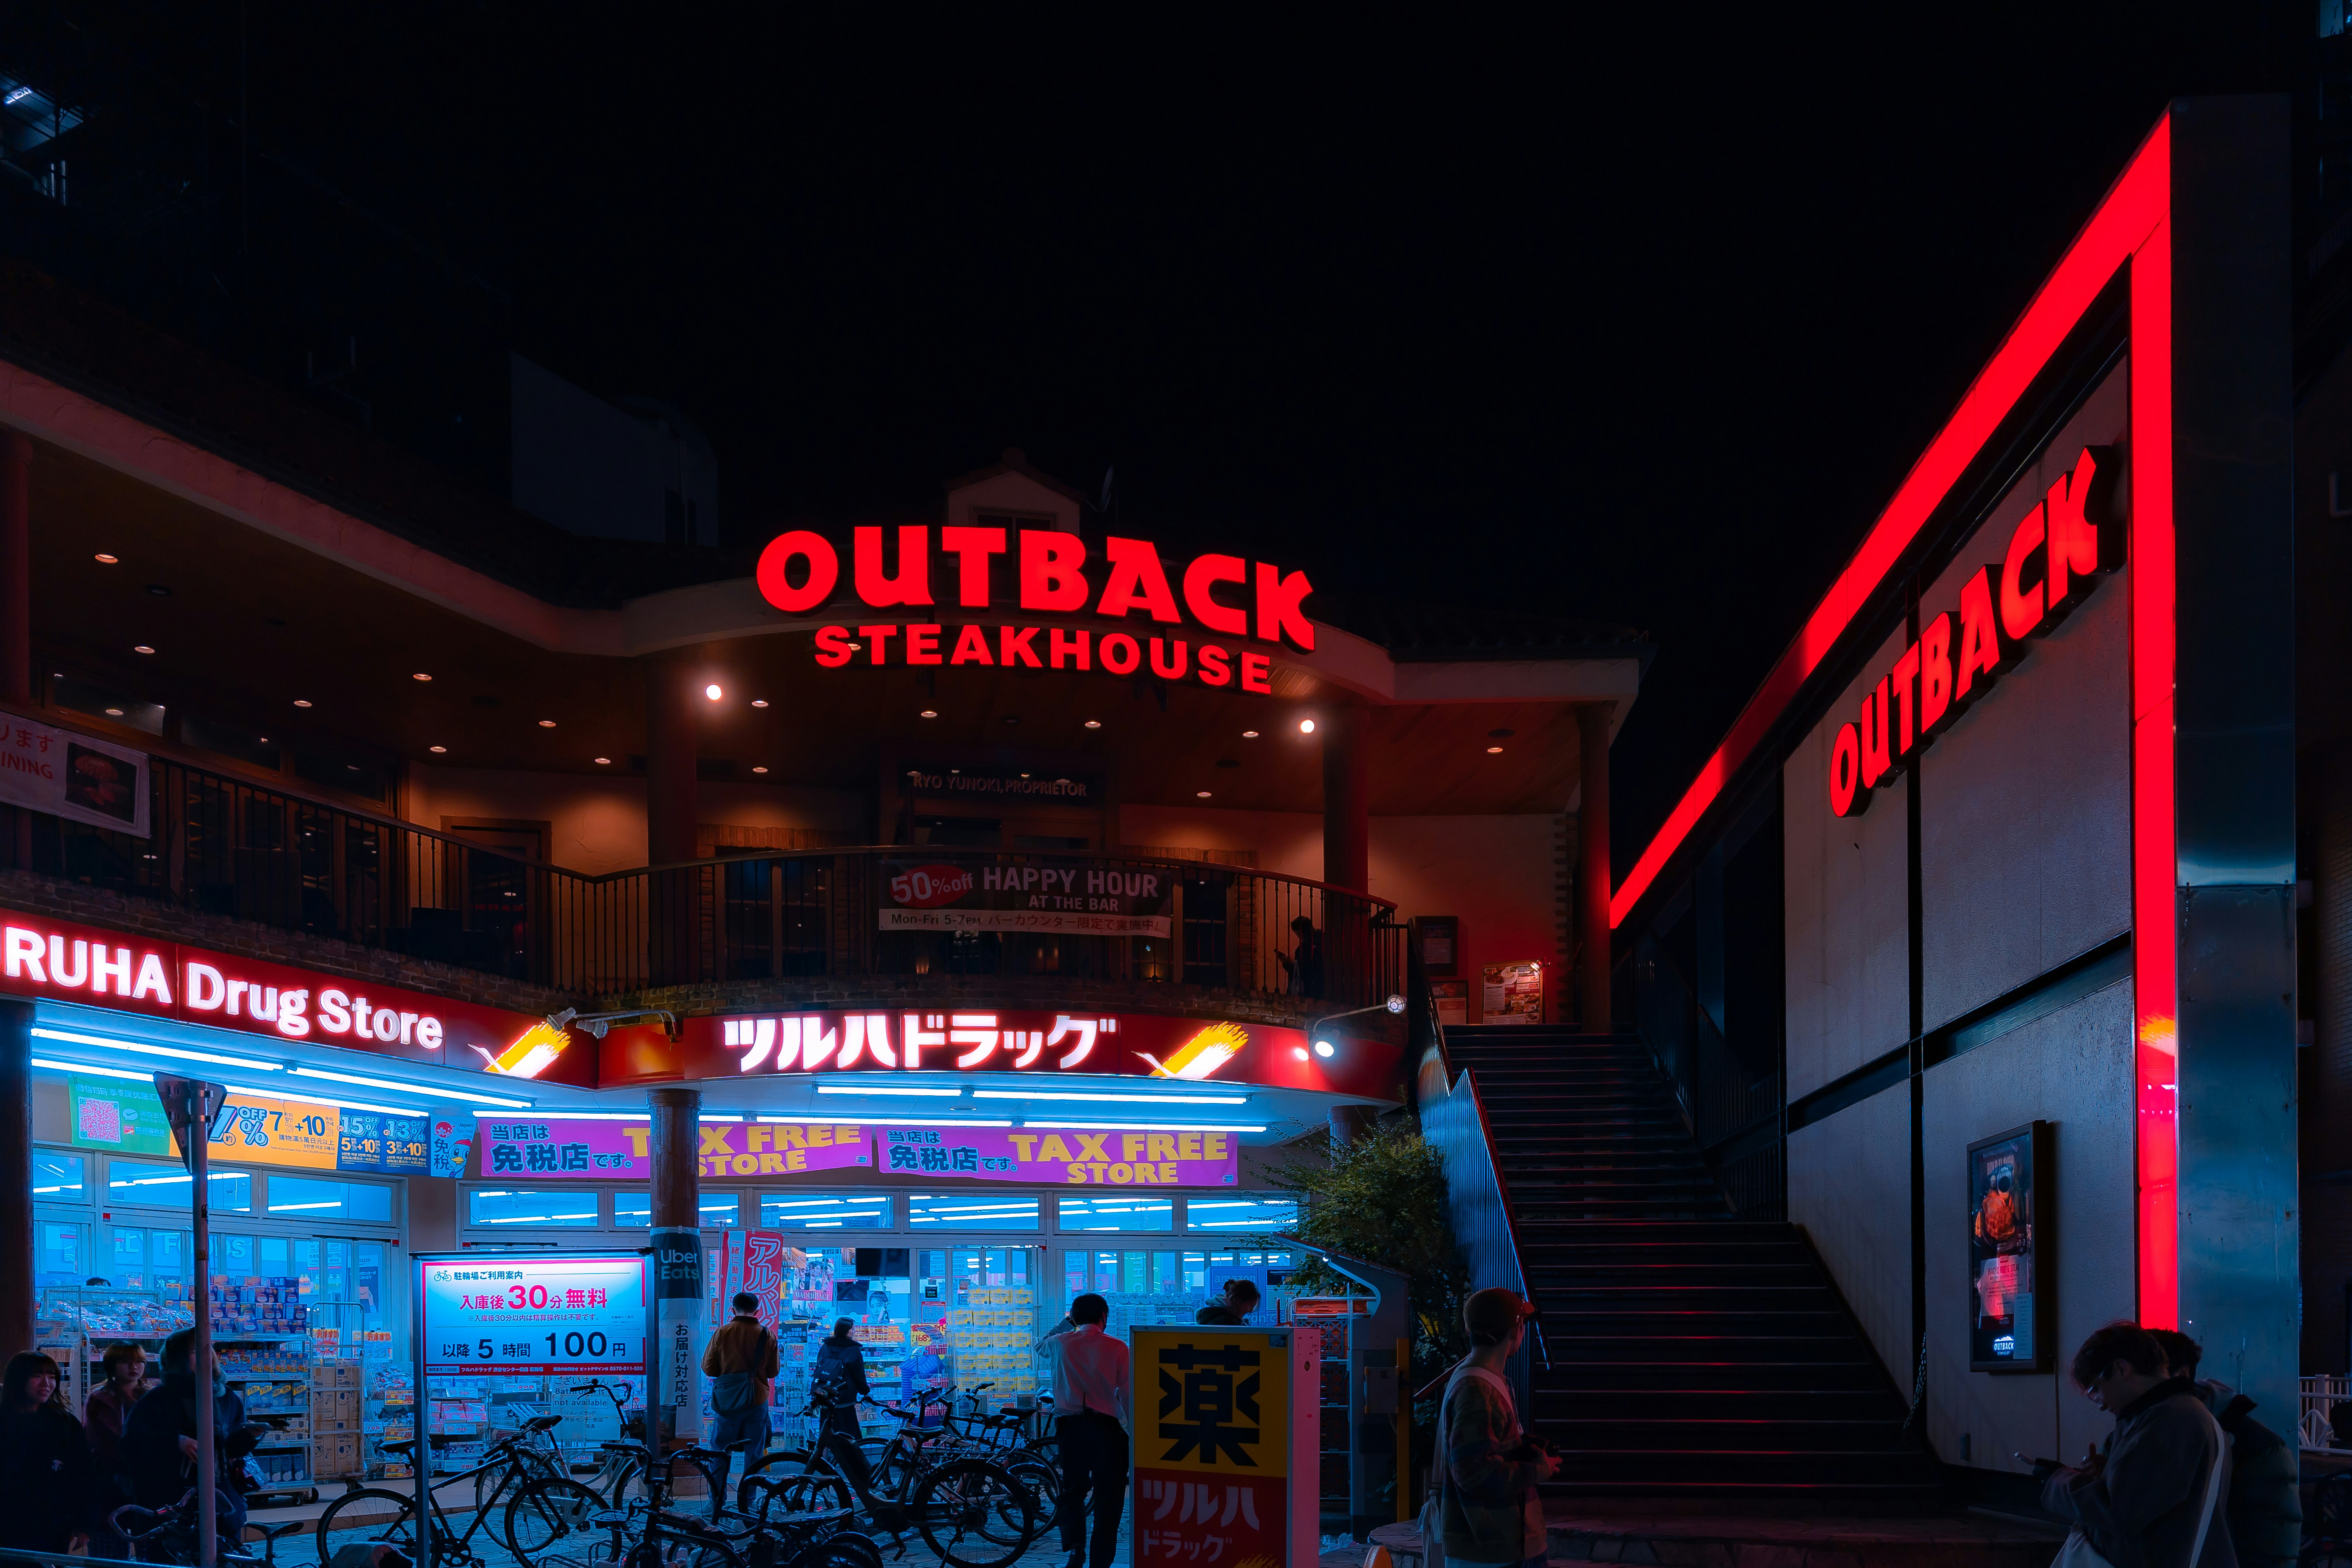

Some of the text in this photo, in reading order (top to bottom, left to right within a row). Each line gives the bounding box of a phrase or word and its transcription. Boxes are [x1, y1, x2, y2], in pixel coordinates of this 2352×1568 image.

[757, 525, 1315, 652] OUTBACK
[1829, 446, 2097, 817] OUTBACK
[814, 624, 1271, 695] STEAKHOUSE
[913, 774, 942, 788] RYO
[1004, 779, 1087, 796] PROPRIETOR
[984, 867, 1159, 897] HAPPY HOUR
[1029, 895, 1119, 912] AT THE BAR
[891, 913, 939, 925] Mon-Fri
[4, 926, 443, 1049] RUHA Drug Store
[723, 1014, 1116, 1073] ツルハドラッグ
[238, 1107, 267, 1120] OFF
[269, 1111, 283, 1131] 7
[341, 1116, 364, 1136] 15
[387, 1120, 411, 1139] 13
[491, 1124, 550, 1141] 当店は
[622, 1125, 861, 1157] TX FREE
[887, 1129, 940, 1144] 当店は
[491, 1142, 633, 1173] 免税店です。
[887, 1144, 1018, 1173] 免税店です。
[1007, 1133, 1228, 1163] TAX FREE
[1066, 1162, 1179, 1184] STORE
[661, 1250, 697, 1263] Uber
[454, 1271, 523, 1281] 駐輪場ご利用案内
[661, 1266, 700, 1279] Eats
[443, 1331, 626, 1359] 以降 5 時間 100 円
[1994, 1342, 2014, 1350] OUTBACK
[674, 1323, 689, 1408] お届け対応店
[554, 1376, 609, 1385] ございまん
[1158, 1343, 1260, 1467] 薬
[1142, 1479, 1260, 1531] ツルハ
[1143, 1529, 1232, 1563] ドラッグ
